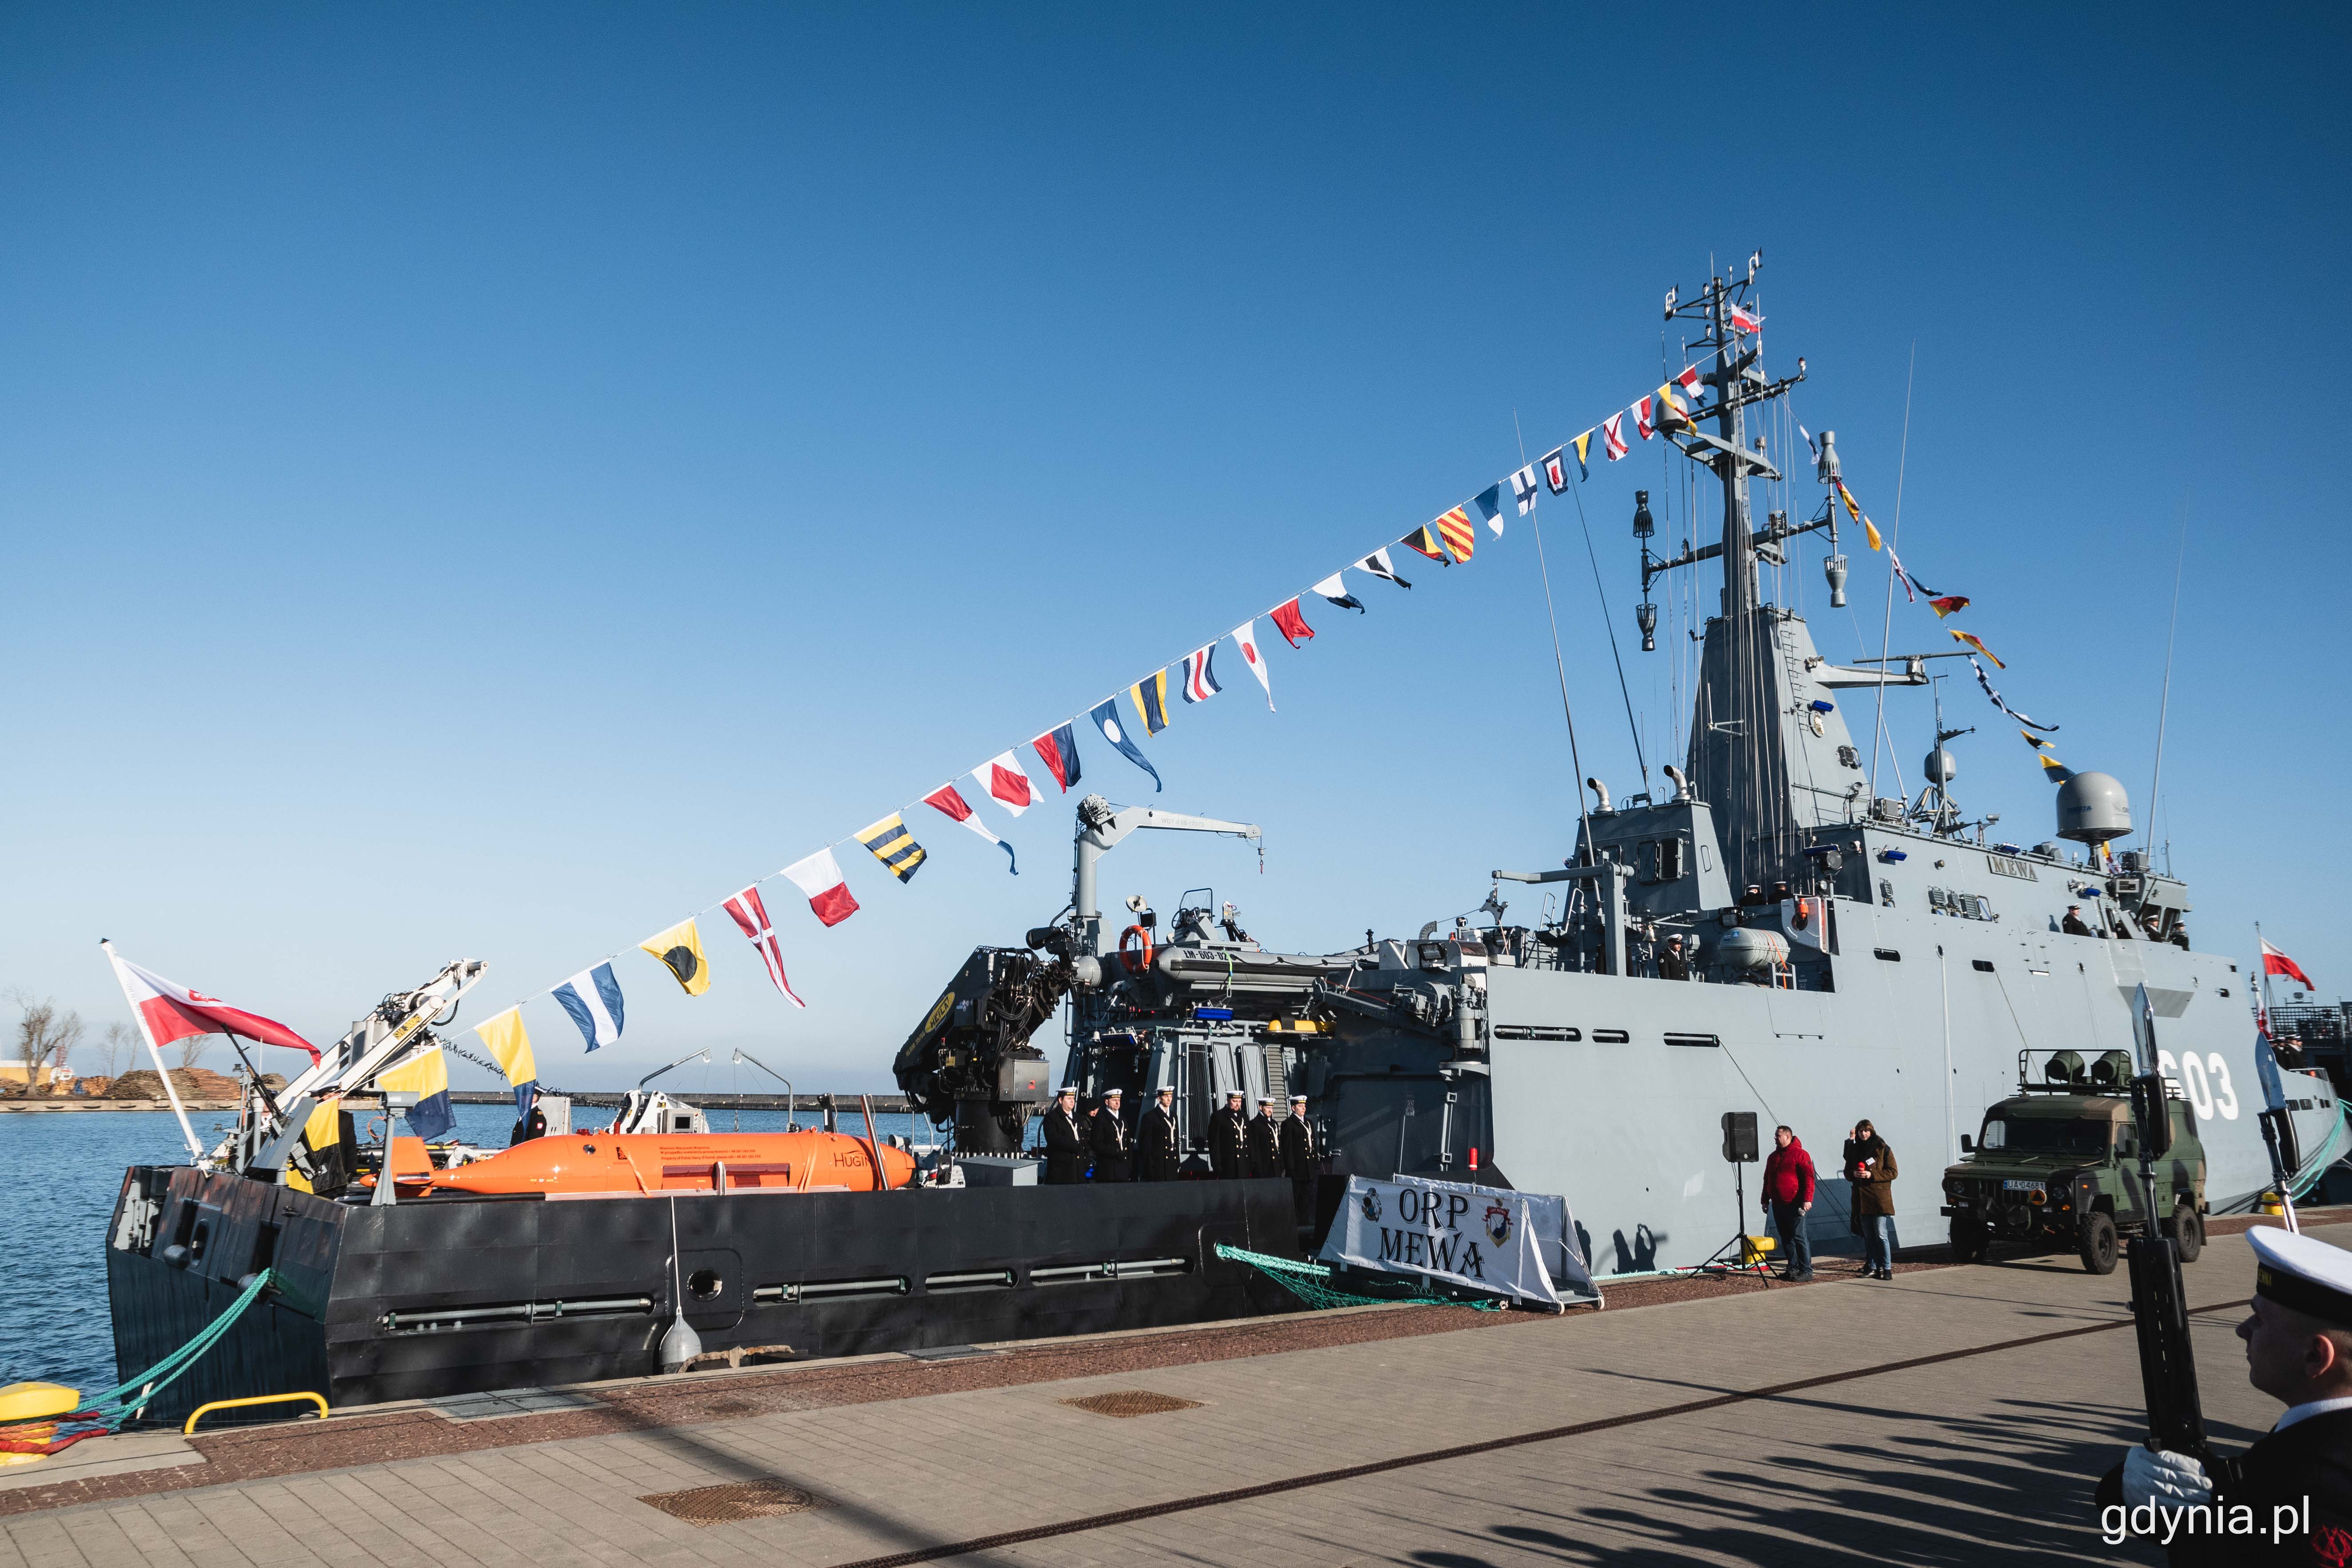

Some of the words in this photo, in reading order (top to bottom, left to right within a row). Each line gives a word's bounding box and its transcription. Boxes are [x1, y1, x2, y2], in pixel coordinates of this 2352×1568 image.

[1992, 856, 2039, 880] MEWA
[930, 996, 950, 1029] HEILA
[2158, 1049, 2239, 1120] 603
[1399, 1188, 1470, 1231] ORP
[1376, 1227, 1486, 1281] MEWA
